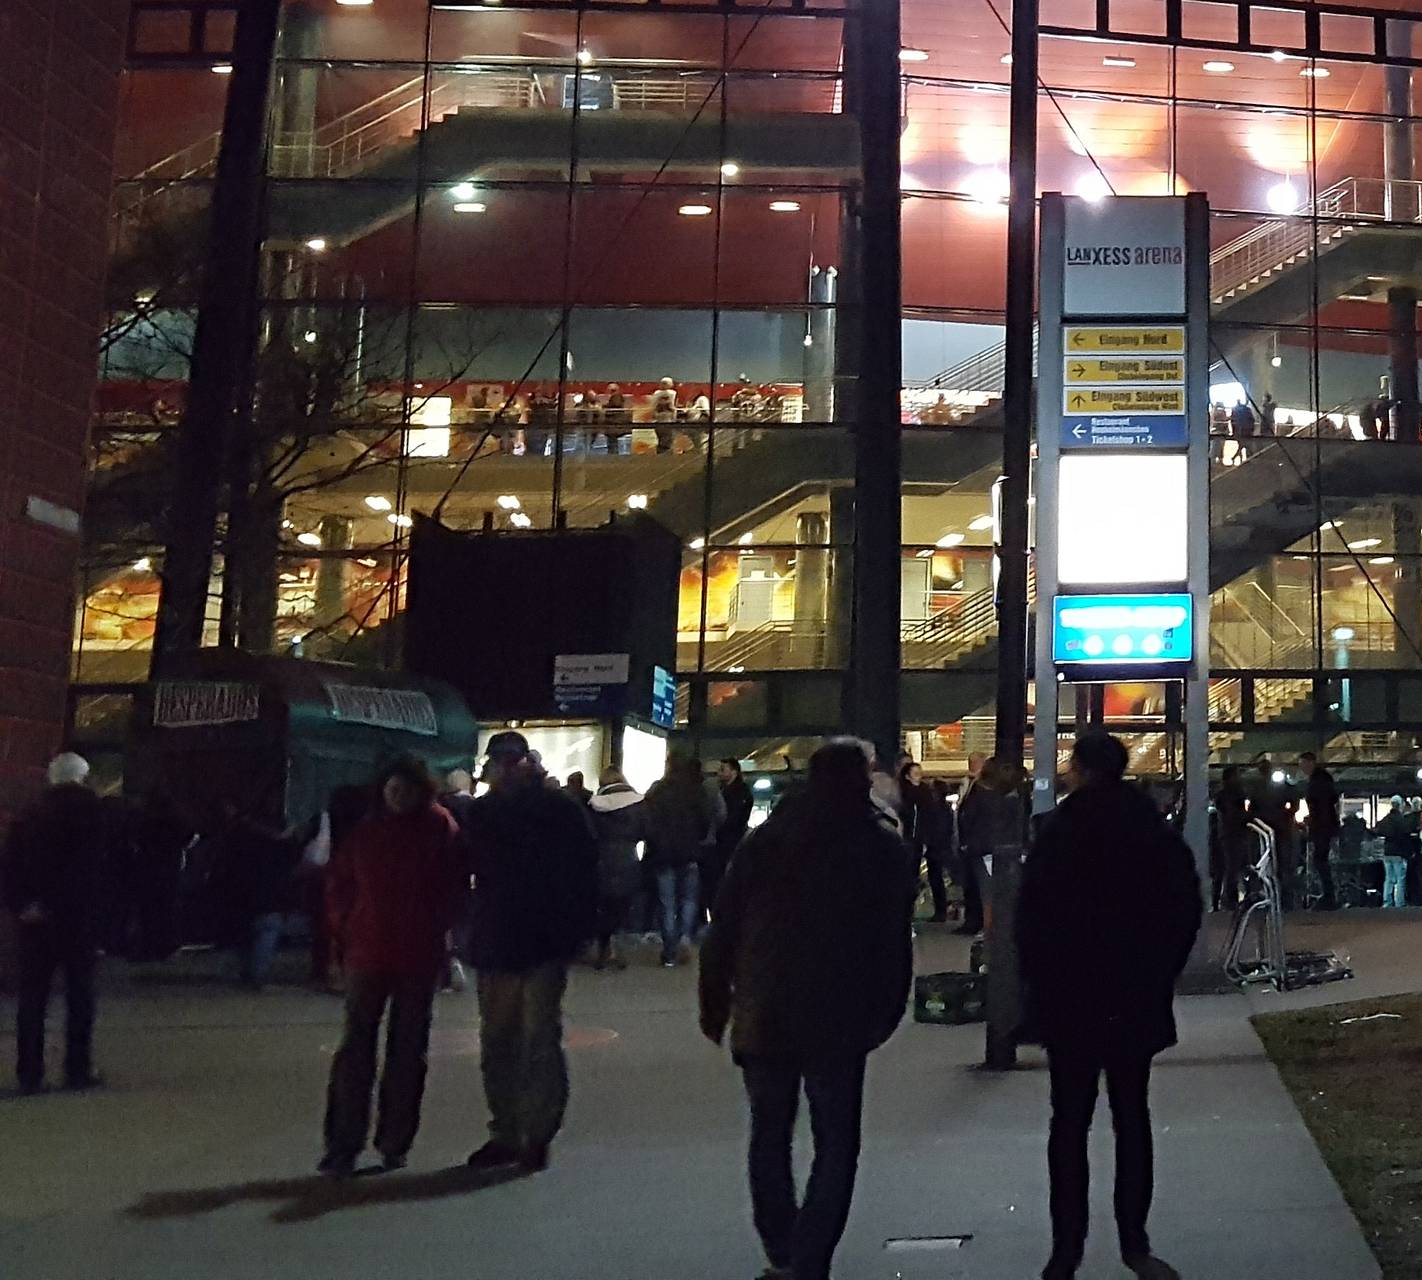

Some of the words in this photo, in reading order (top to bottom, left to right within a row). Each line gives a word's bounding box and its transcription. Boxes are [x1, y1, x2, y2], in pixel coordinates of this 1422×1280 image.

[1067, 247, 1131, 266] LANXESS
[1134, 246, 1183, 265] arena
[1099, 334, 1140, 346] Eingang
[1143, 334, 1168, 345] Nord
[1099, 361, 1140, 372] Eingang
[1091, 390, 1132, 402] Eingang
[1136, 390, 1179, 402] Südwest
